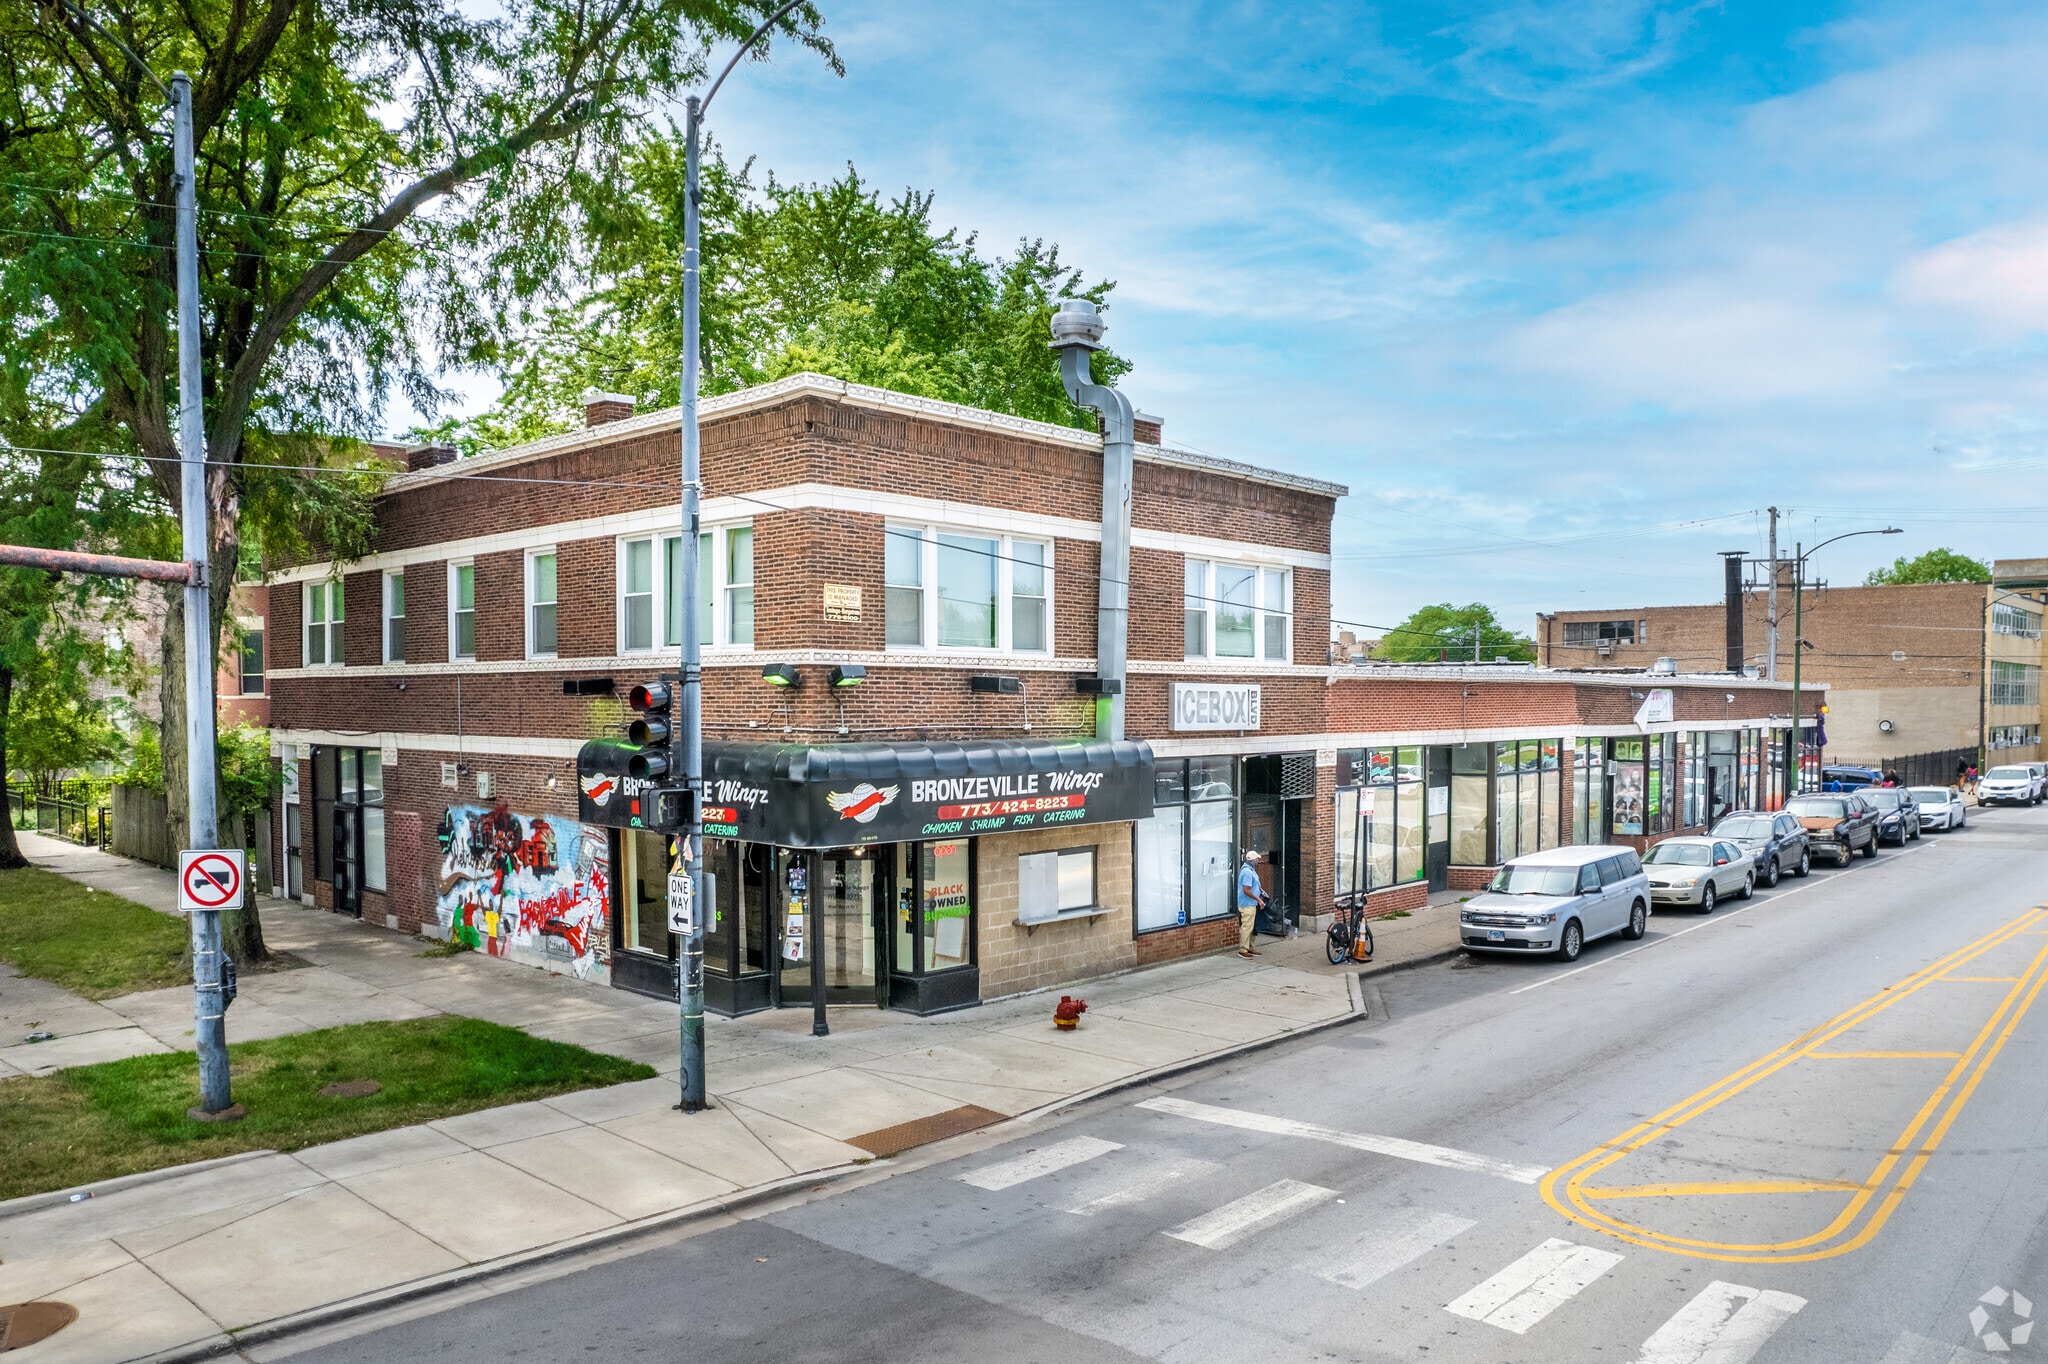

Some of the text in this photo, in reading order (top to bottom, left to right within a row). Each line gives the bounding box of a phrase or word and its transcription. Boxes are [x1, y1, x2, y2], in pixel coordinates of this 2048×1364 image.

[1177, 690, 1246, 724] ICEBOX
[714, 779, 769, 810] Wingz
[912, 770, 1103, 802] BRONZEVILLE Wings
[960, 796, 1068, 816] 773/424-8223
[704, 823, 739, 836] CATERING
[922, 808, 1085, 834] CHICKEN SHRIMP FISH CATERING
[671, 880, 688, 894] ONE
[931, 884, 963, 897] BLACK
[671, 895, 689, 910] WAY
[930, 895, 966, 909] OWNED
[924, 905, 970, 922] BUSINESS
